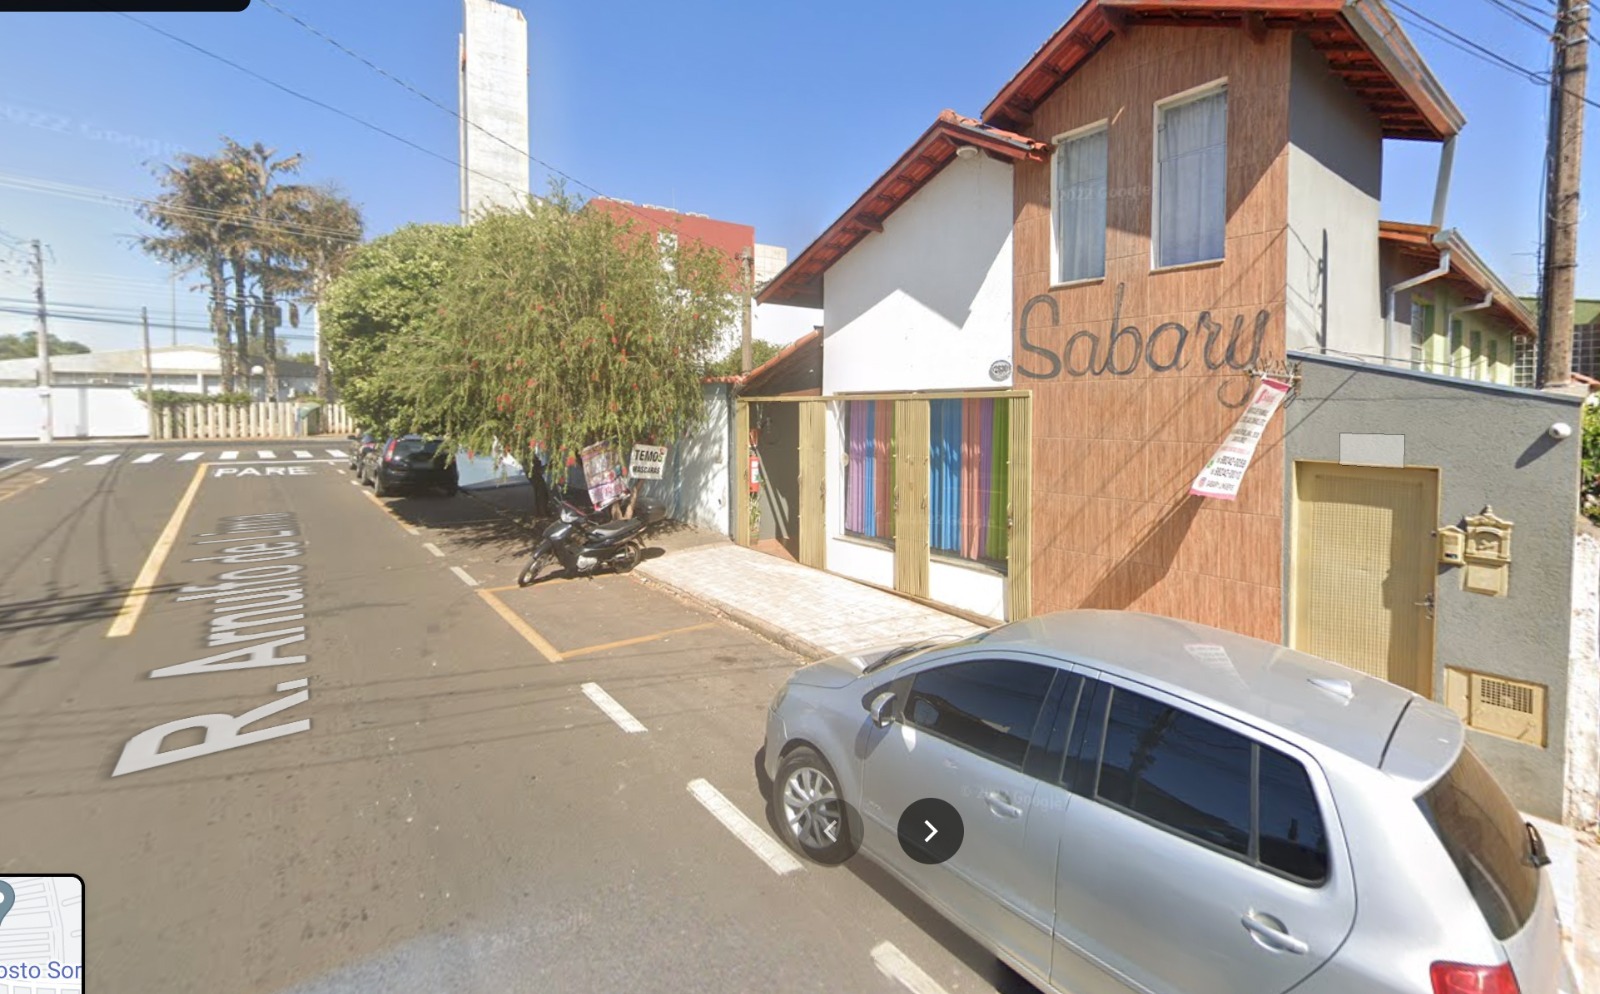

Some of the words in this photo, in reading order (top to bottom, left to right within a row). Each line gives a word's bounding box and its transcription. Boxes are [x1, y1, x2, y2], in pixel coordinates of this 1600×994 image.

[1017, 282, 1269, 408] Sabary
[635, 449, 664, 462] TEMOS
[214, 466, 312, 478] PARE
